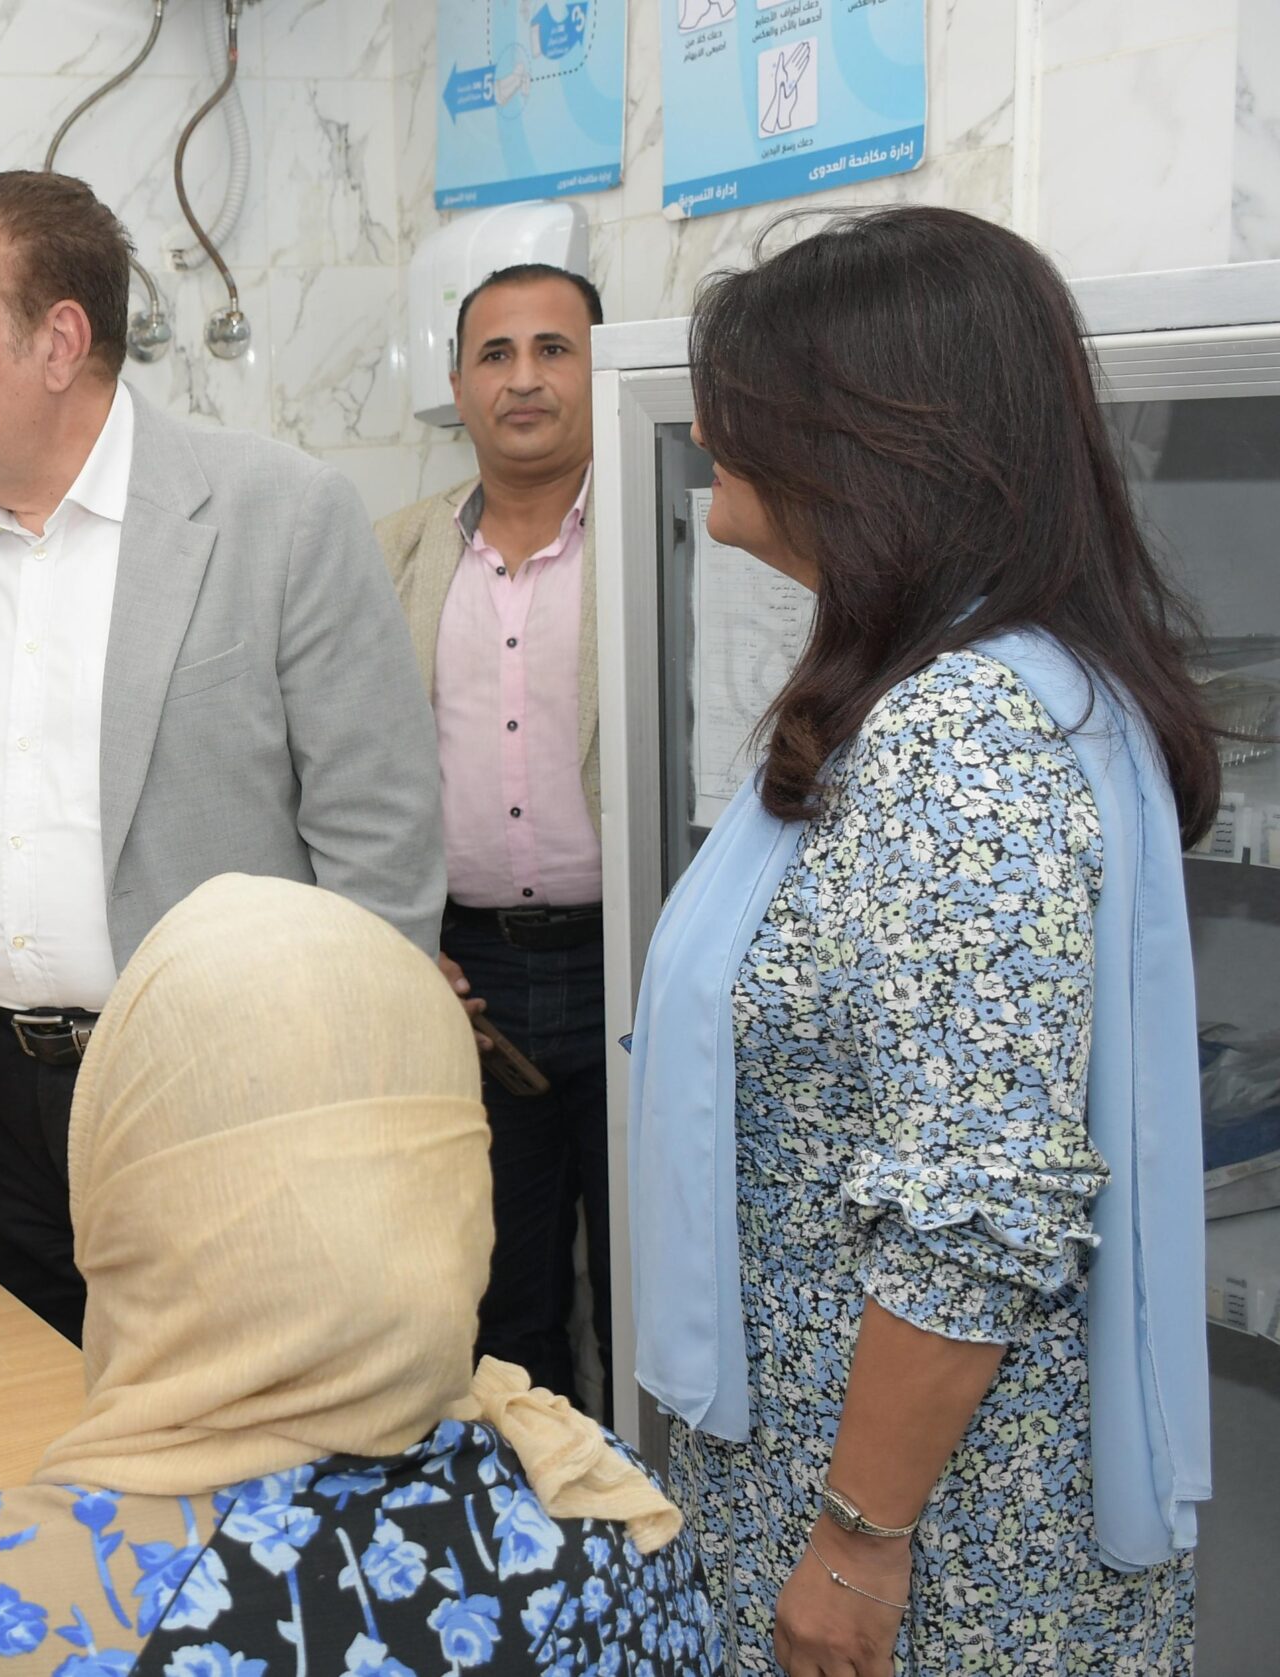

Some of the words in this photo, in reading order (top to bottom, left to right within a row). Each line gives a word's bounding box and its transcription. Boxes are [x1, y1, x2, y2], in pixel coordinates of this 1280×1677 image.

[571, 4, 585, 33] 3
[483, 72, 493, 101] 5
[848, 148, 887, 168] مكافحة
[890, 140, 914, 160] إدارة
[808, 156, 847, 180] العدوى
[716, 181, 738, 200] إدارة
